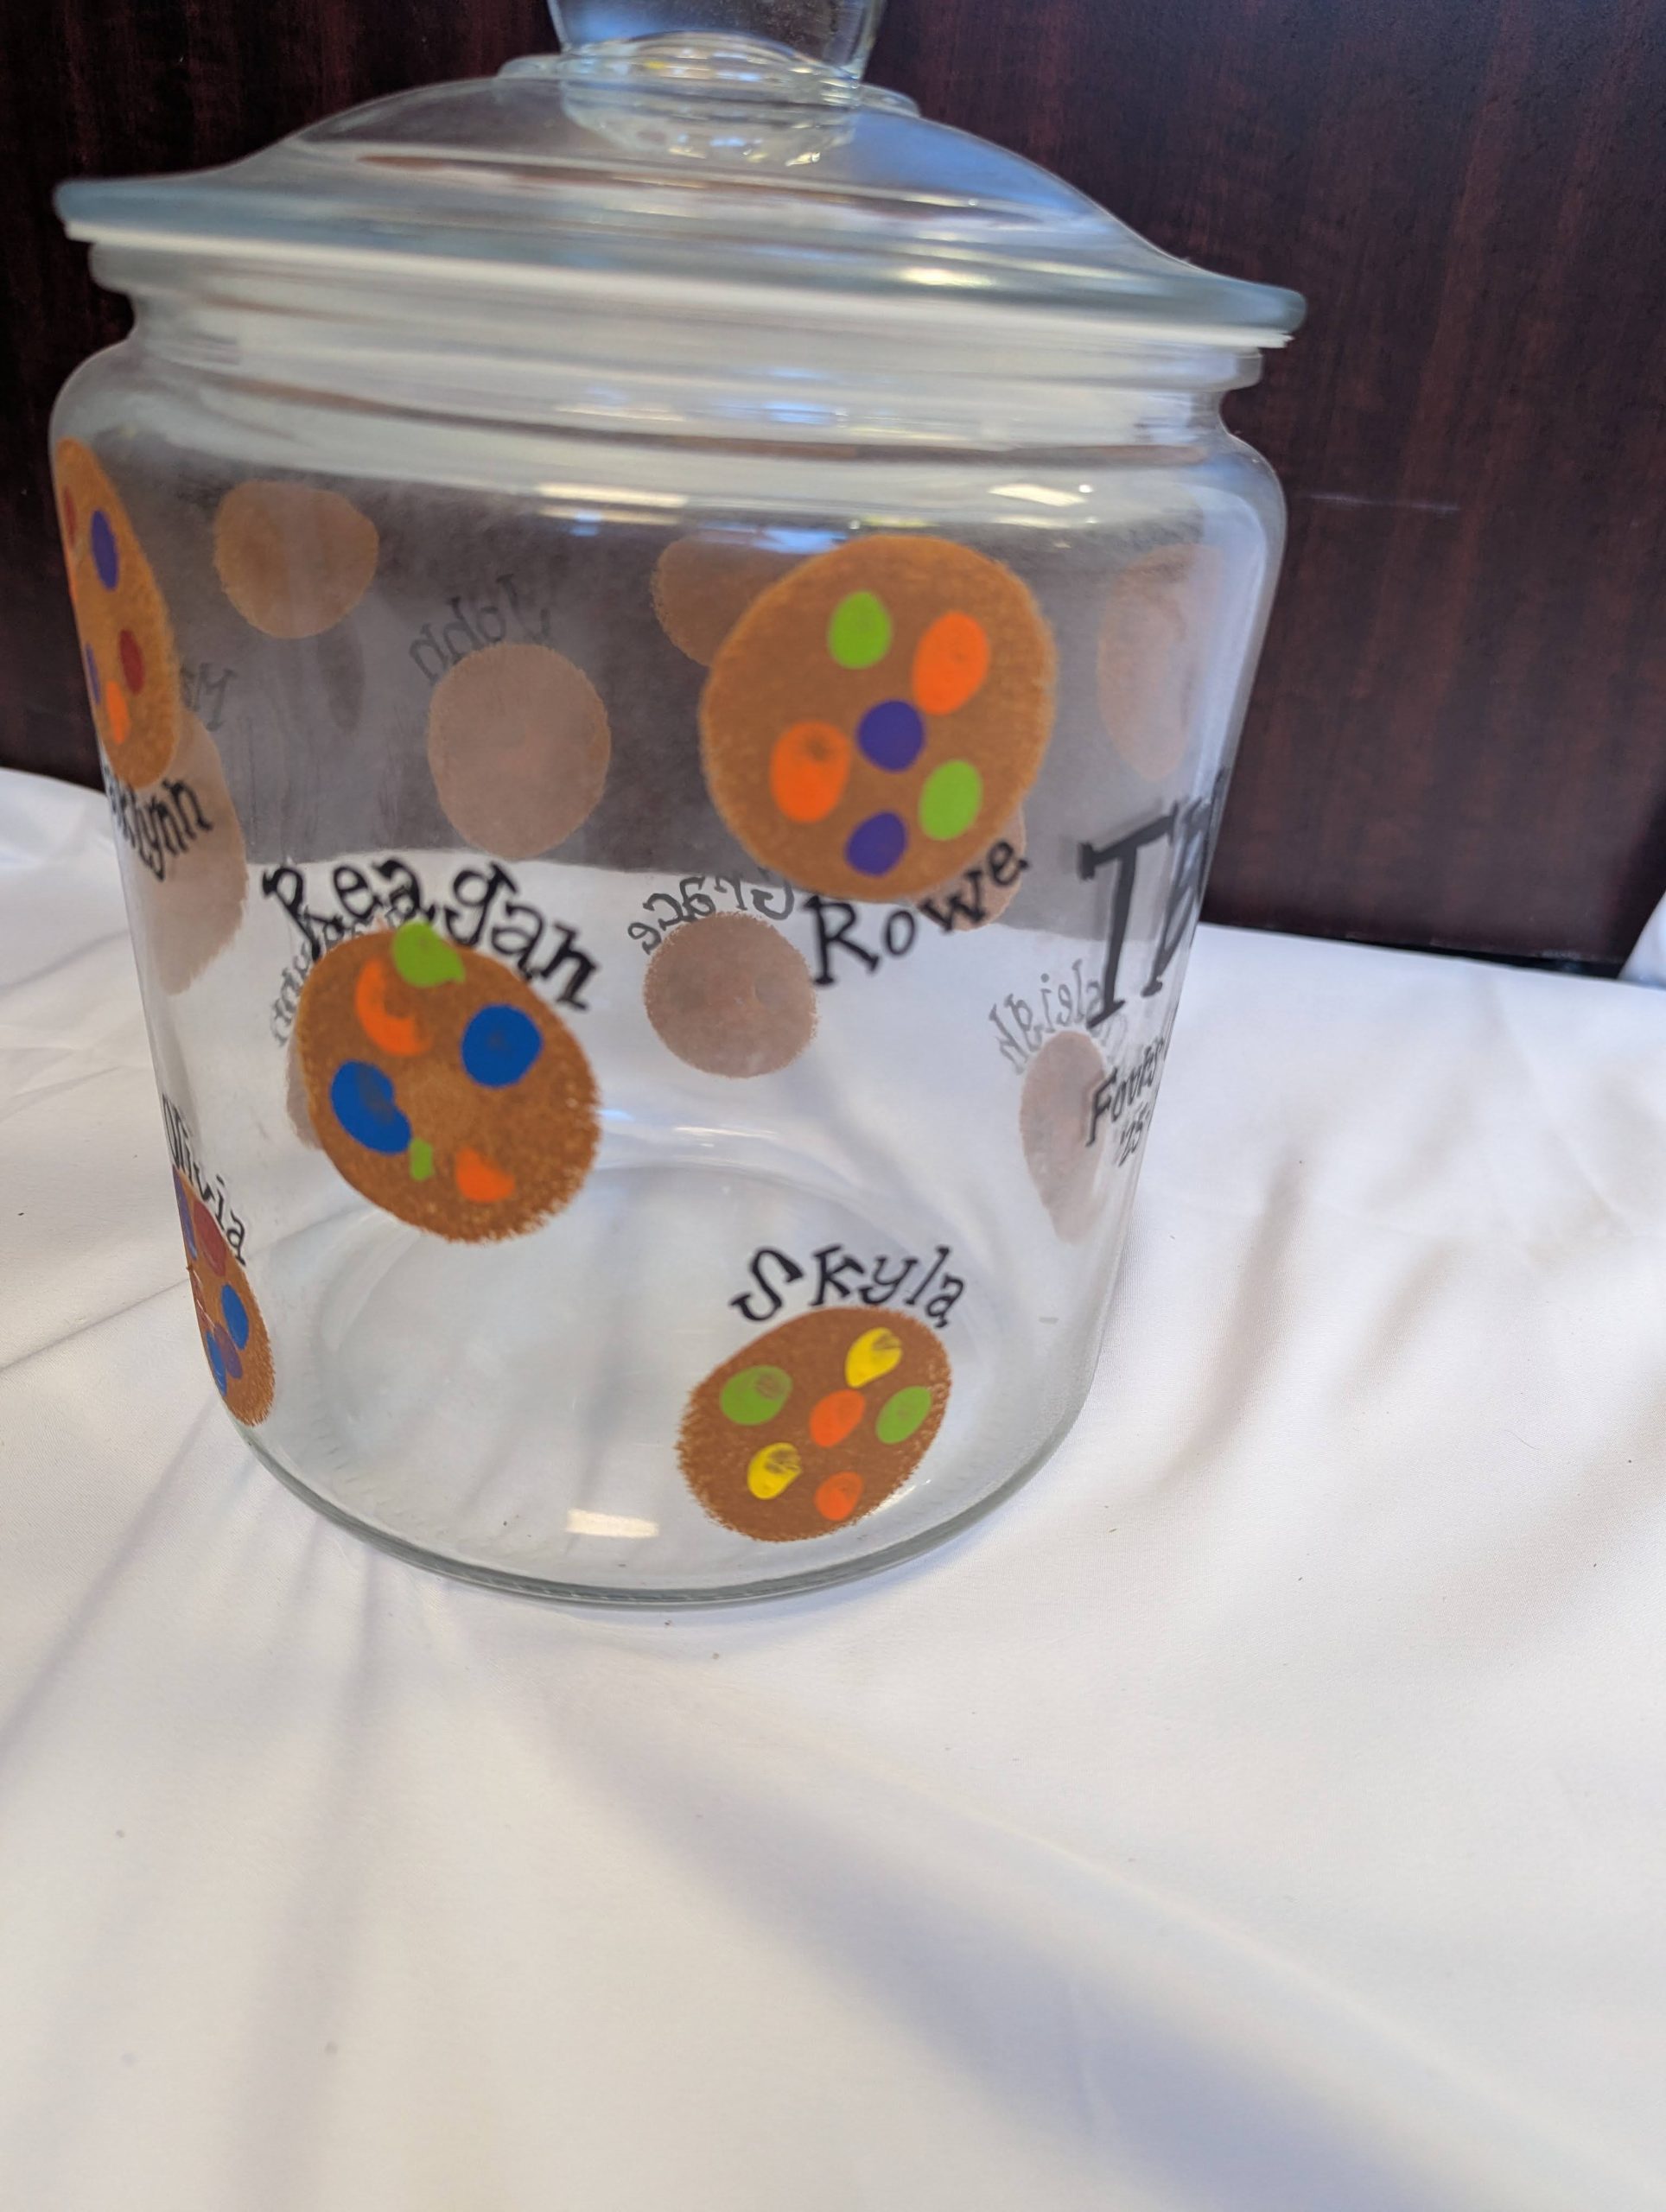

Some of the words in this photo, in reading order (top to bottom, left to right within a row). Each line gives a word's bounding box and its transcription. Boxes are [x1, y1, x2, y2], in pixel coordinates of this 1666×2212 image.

[262, 859, 598, 1012] Reagan
[804, 841, 1029, 986] Rowe
[728, 1243, 965, 1328] Skyla
